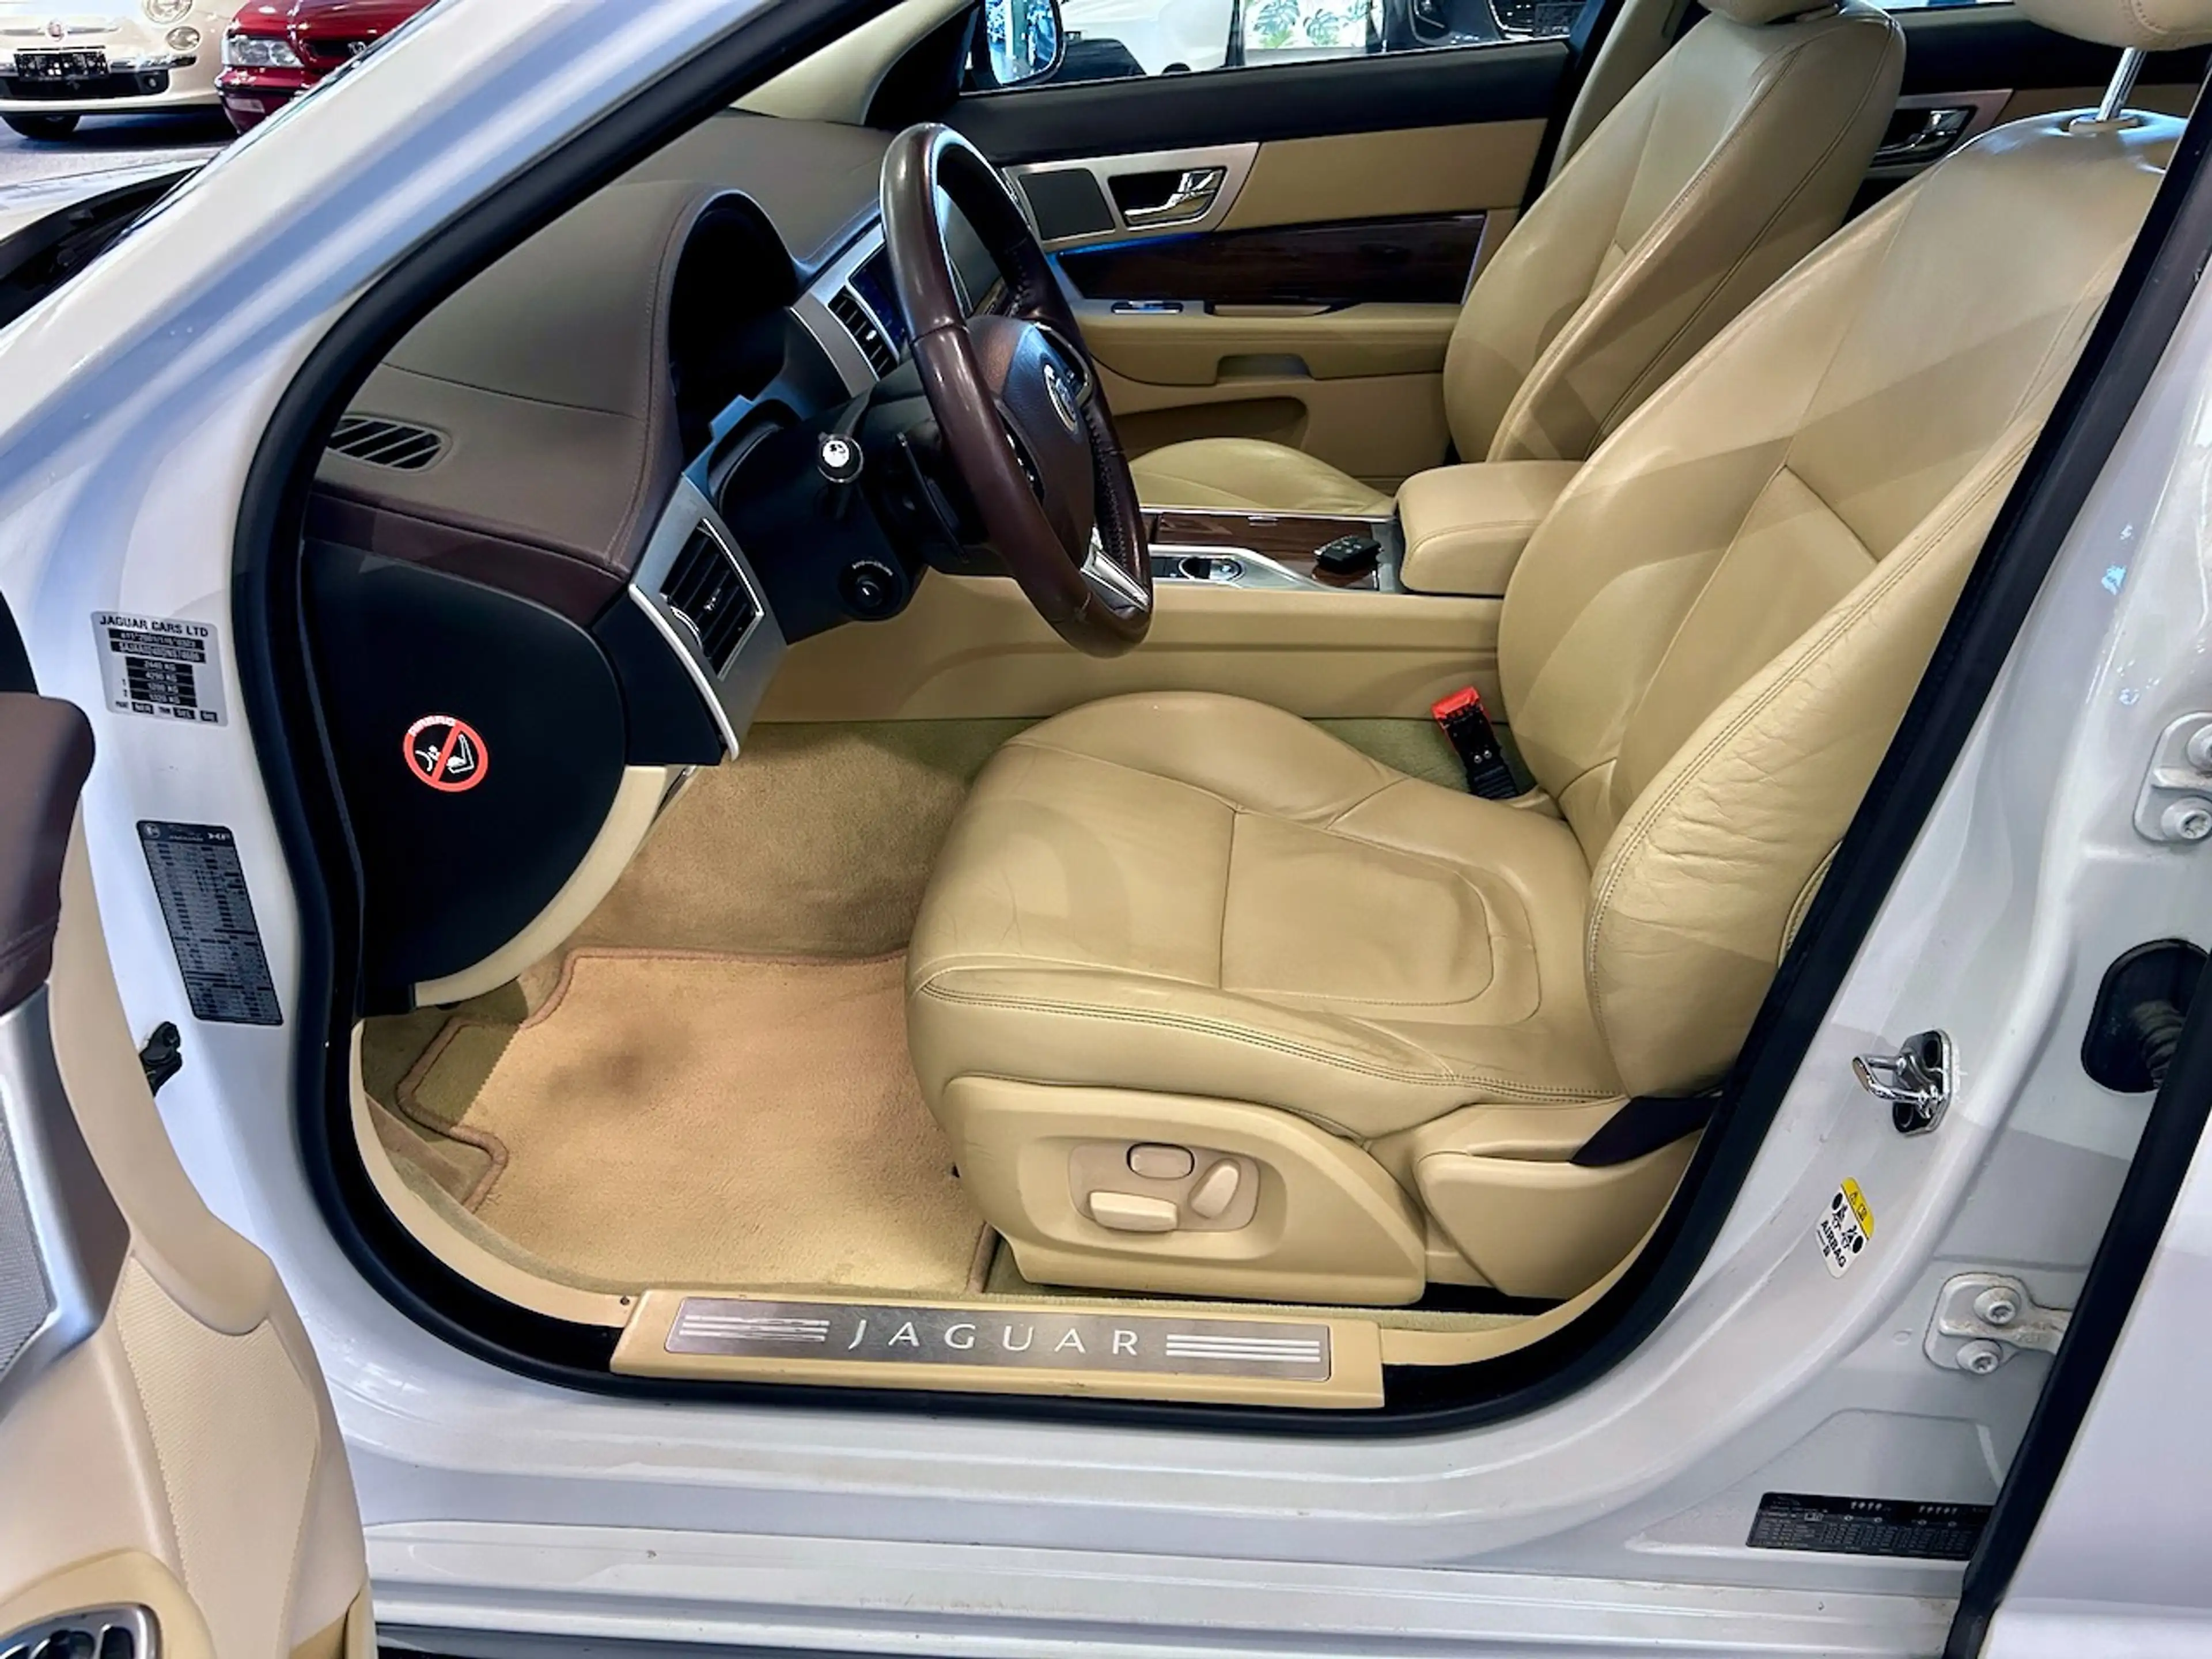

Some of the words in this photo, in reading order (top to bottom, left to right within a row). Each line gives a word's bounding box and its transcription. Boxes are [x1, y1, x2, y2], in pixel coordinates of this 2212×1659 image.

[100, 615, 147, 630] JAGUAR
[151, 620, 182, 634] CARS
[186, 625, 209, 637] LTD
[1821, 1219, 1847, 1268] AIRBAG
[848, 1319, 1139, 1356] JAGUAR
